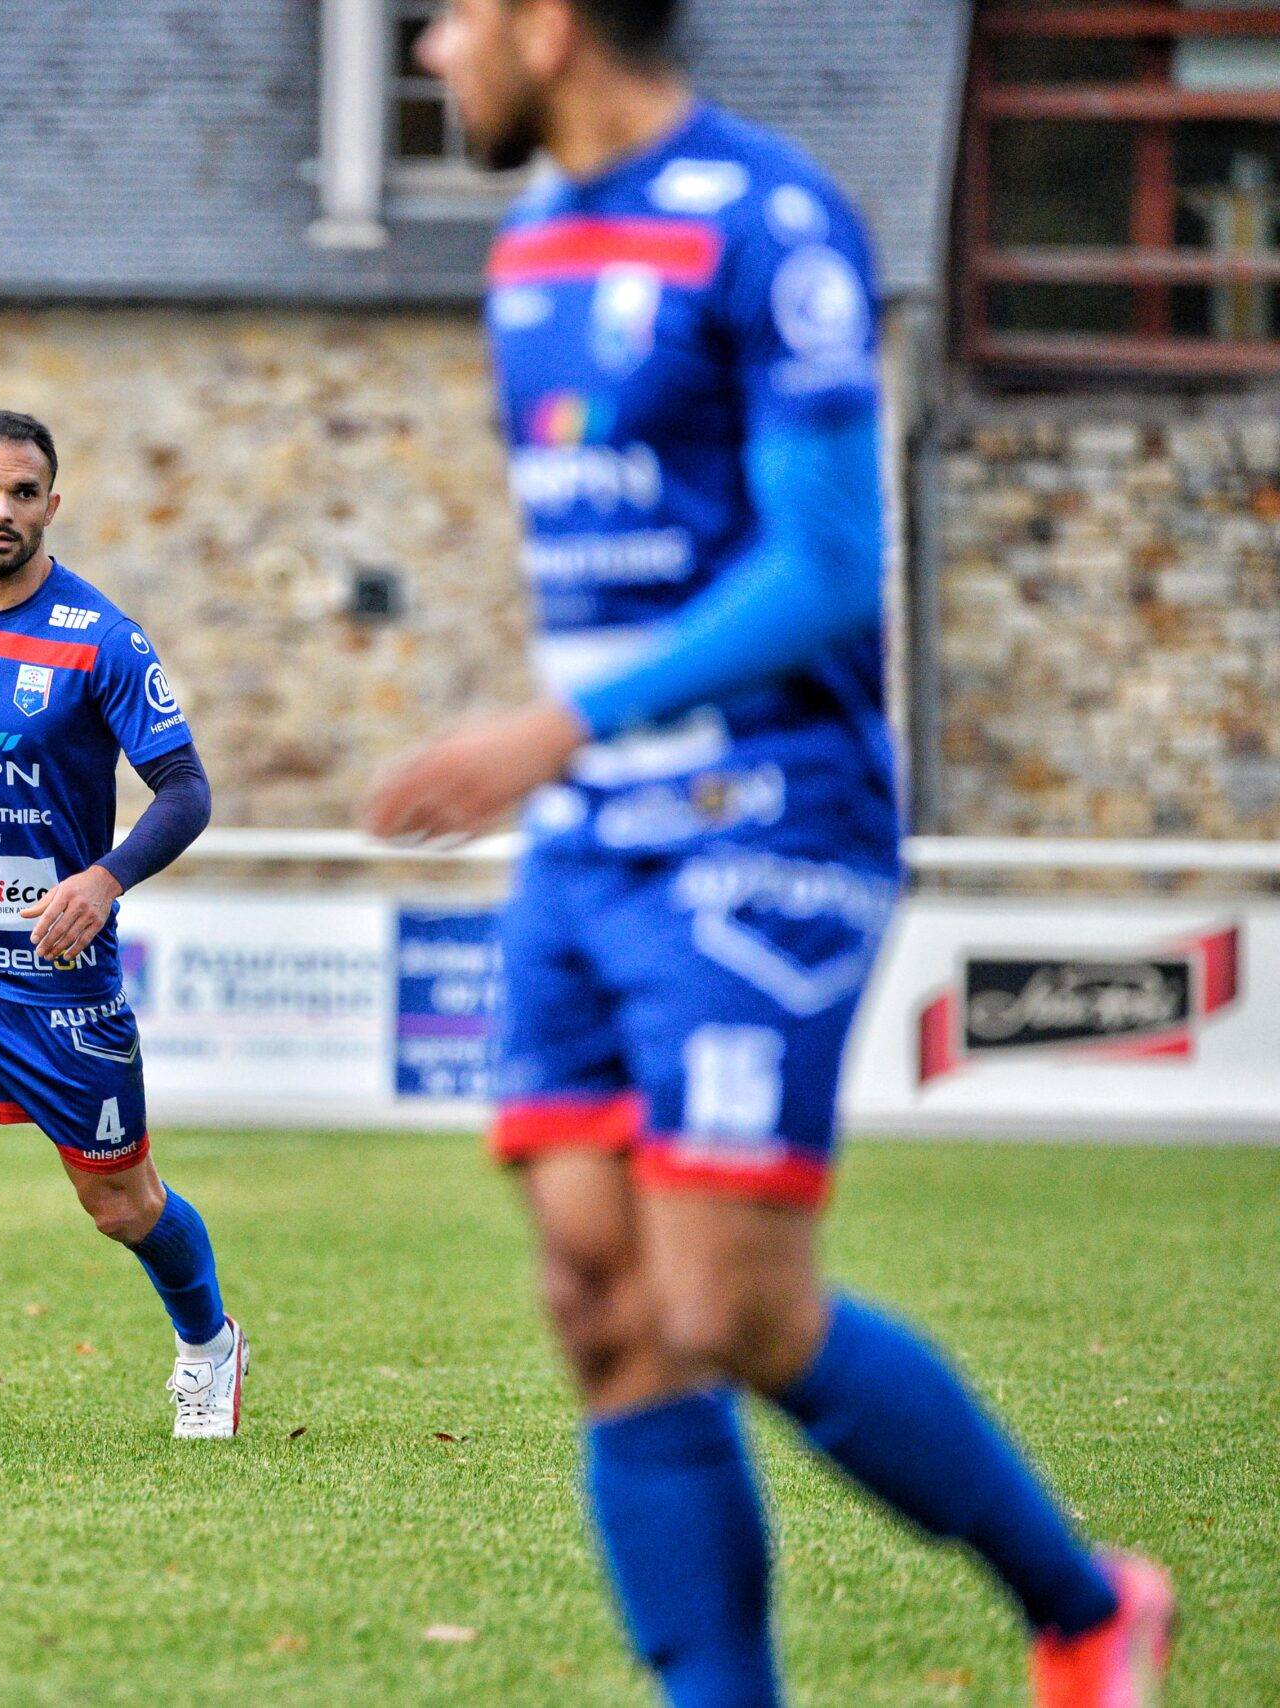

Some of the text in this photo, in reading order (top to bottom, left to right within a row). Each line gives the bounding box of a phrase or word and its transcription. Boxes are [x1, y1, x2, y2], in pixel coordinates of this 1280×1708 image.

[50, 987, 127, 1029] AUTOP
[96, 1096, 126, 1145] 4
[83, 1141, 137, 1160] uhlsport
